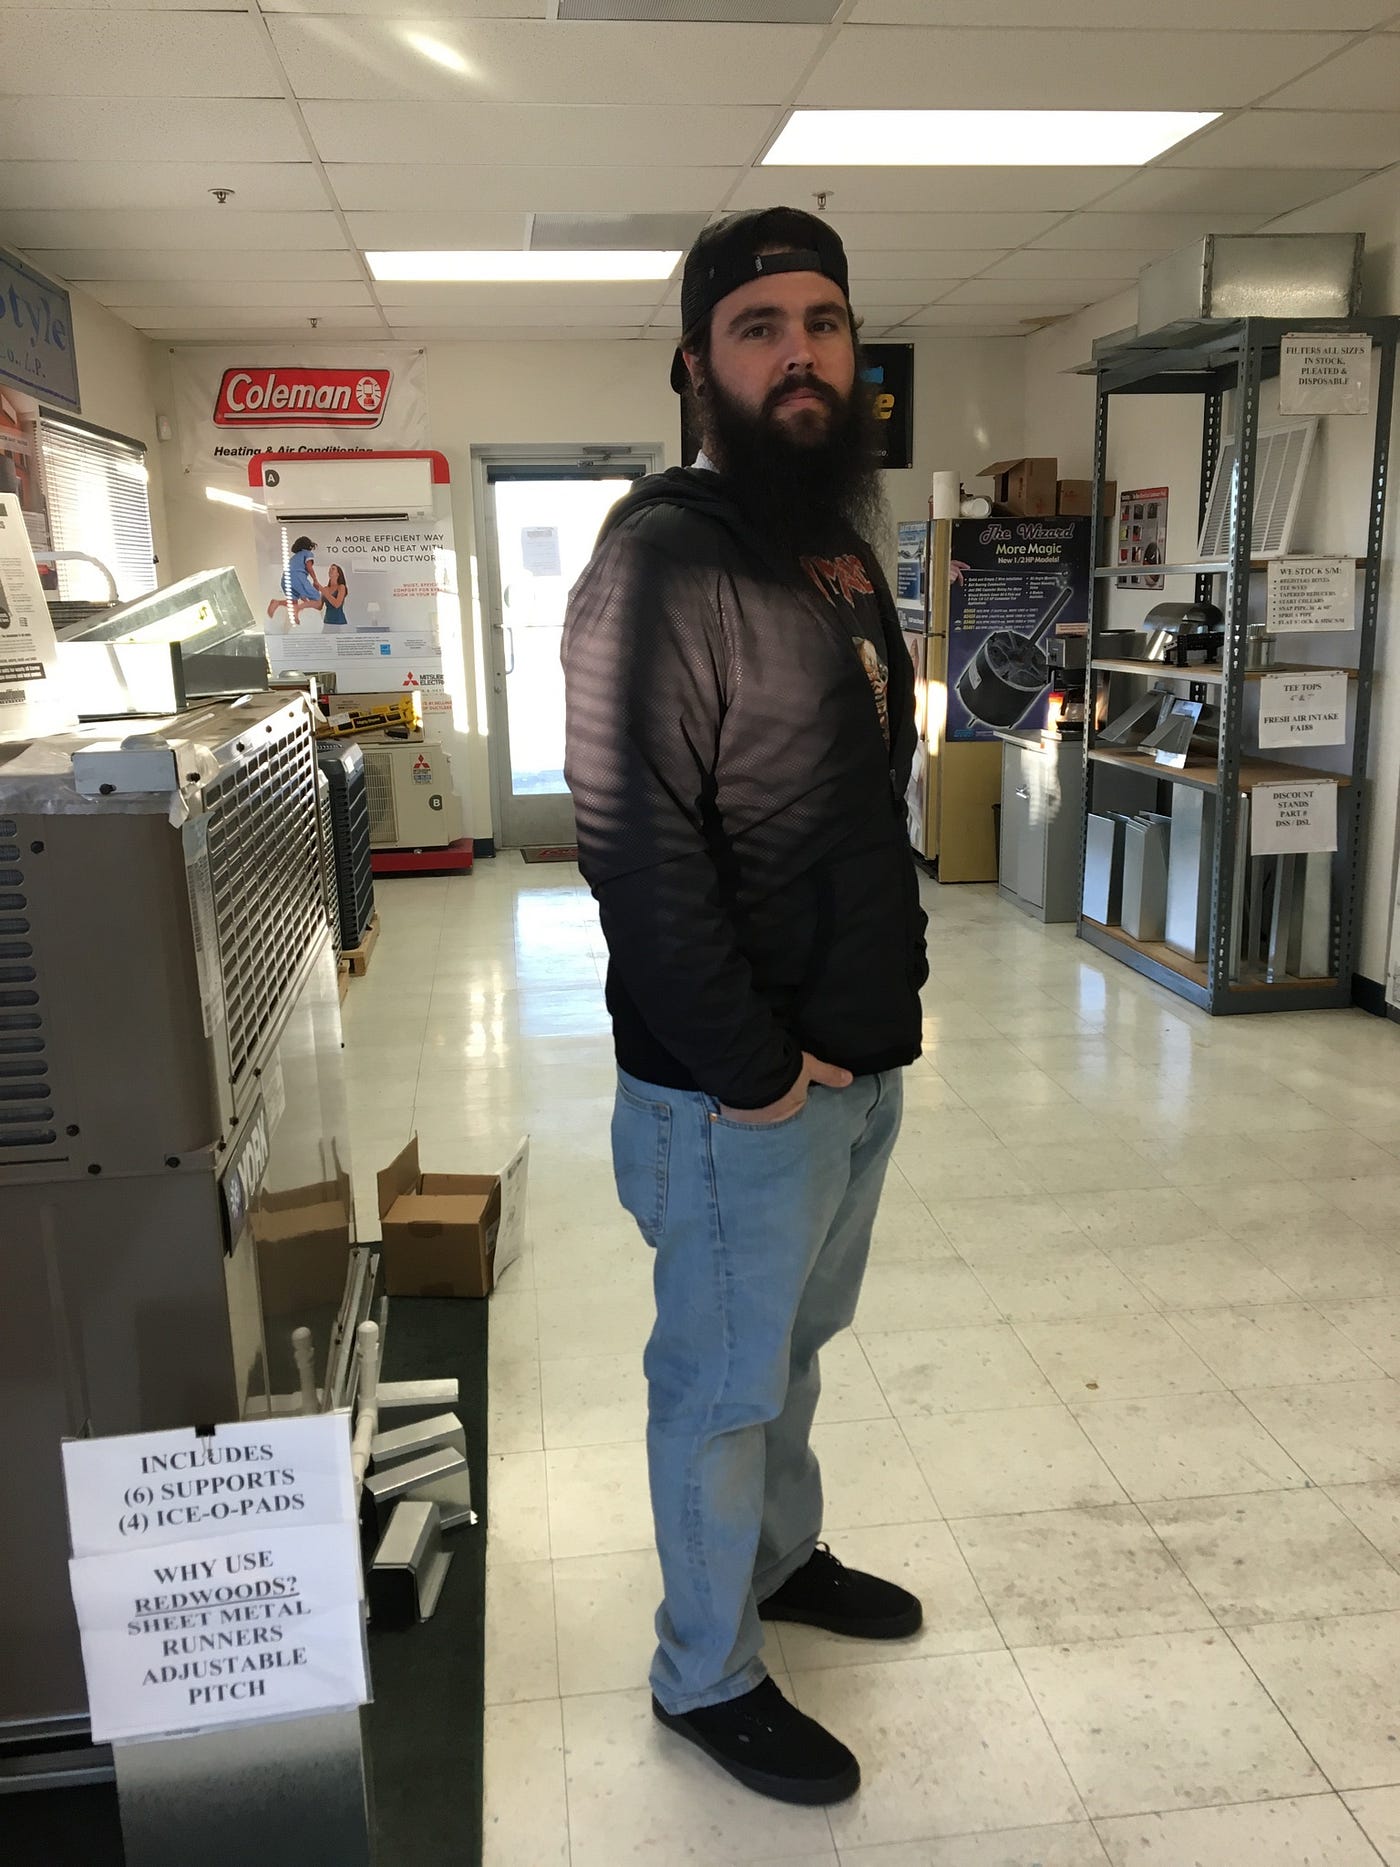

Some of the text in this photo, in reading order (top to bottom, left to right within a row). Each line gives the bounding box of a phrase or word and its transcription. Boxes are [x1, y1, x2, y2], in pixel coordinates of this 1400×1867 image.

[226, 373, 351, 412] Coleman
[214, 446, 261, 457] Heating
[265, 446, 273, 454] &
[344, 535, 371, 543] MORE
[374, 534, 421, 542] EFFICIENT
[980, 522, 1075, 544] The Wizard
[326, 546, 339, 554] TO
[341, 545, 368, 553] COOL
[393, 544, 416, 552] HEAT
[420, 544, 443, 552] WITH
[995, 543, 1062, 555] More Magic
[372, 554, 436, 563] NO DUCTWOR
[1284, 683, 1322, 692] TEE TOPS
[1263, 713, 1339, 724] FRESH AIR INTAKE
[433, 799, 440, 807] B
[1273, 791, 1315, 800] DISCOUNT
[1278, 801, 1309, 809] STANDS
[1280, 810, 1301, 818] PART
[1296, 818, 1311, 826] DSL
[237, 1108, 268, 1210] YORK
[140, 1444, 274, 1475] INCLUDES
[123, 1468, 295, 1508] (6) SUPPORTS
[118, 1493, 305, 1536] (4) ICE-O-PADS
[154, 1550, 274, 1585] WHY USE
[134, 1576, 298, 1614] REDWOODS?
[127, 1600, 312, 1636] SHEET METAL
[162, 1624, 283, 1657] RUNNERS
[142, 1647, 308, 1686] ADJUSTABLE
[188, 1679, 266, 1705] PITCH
